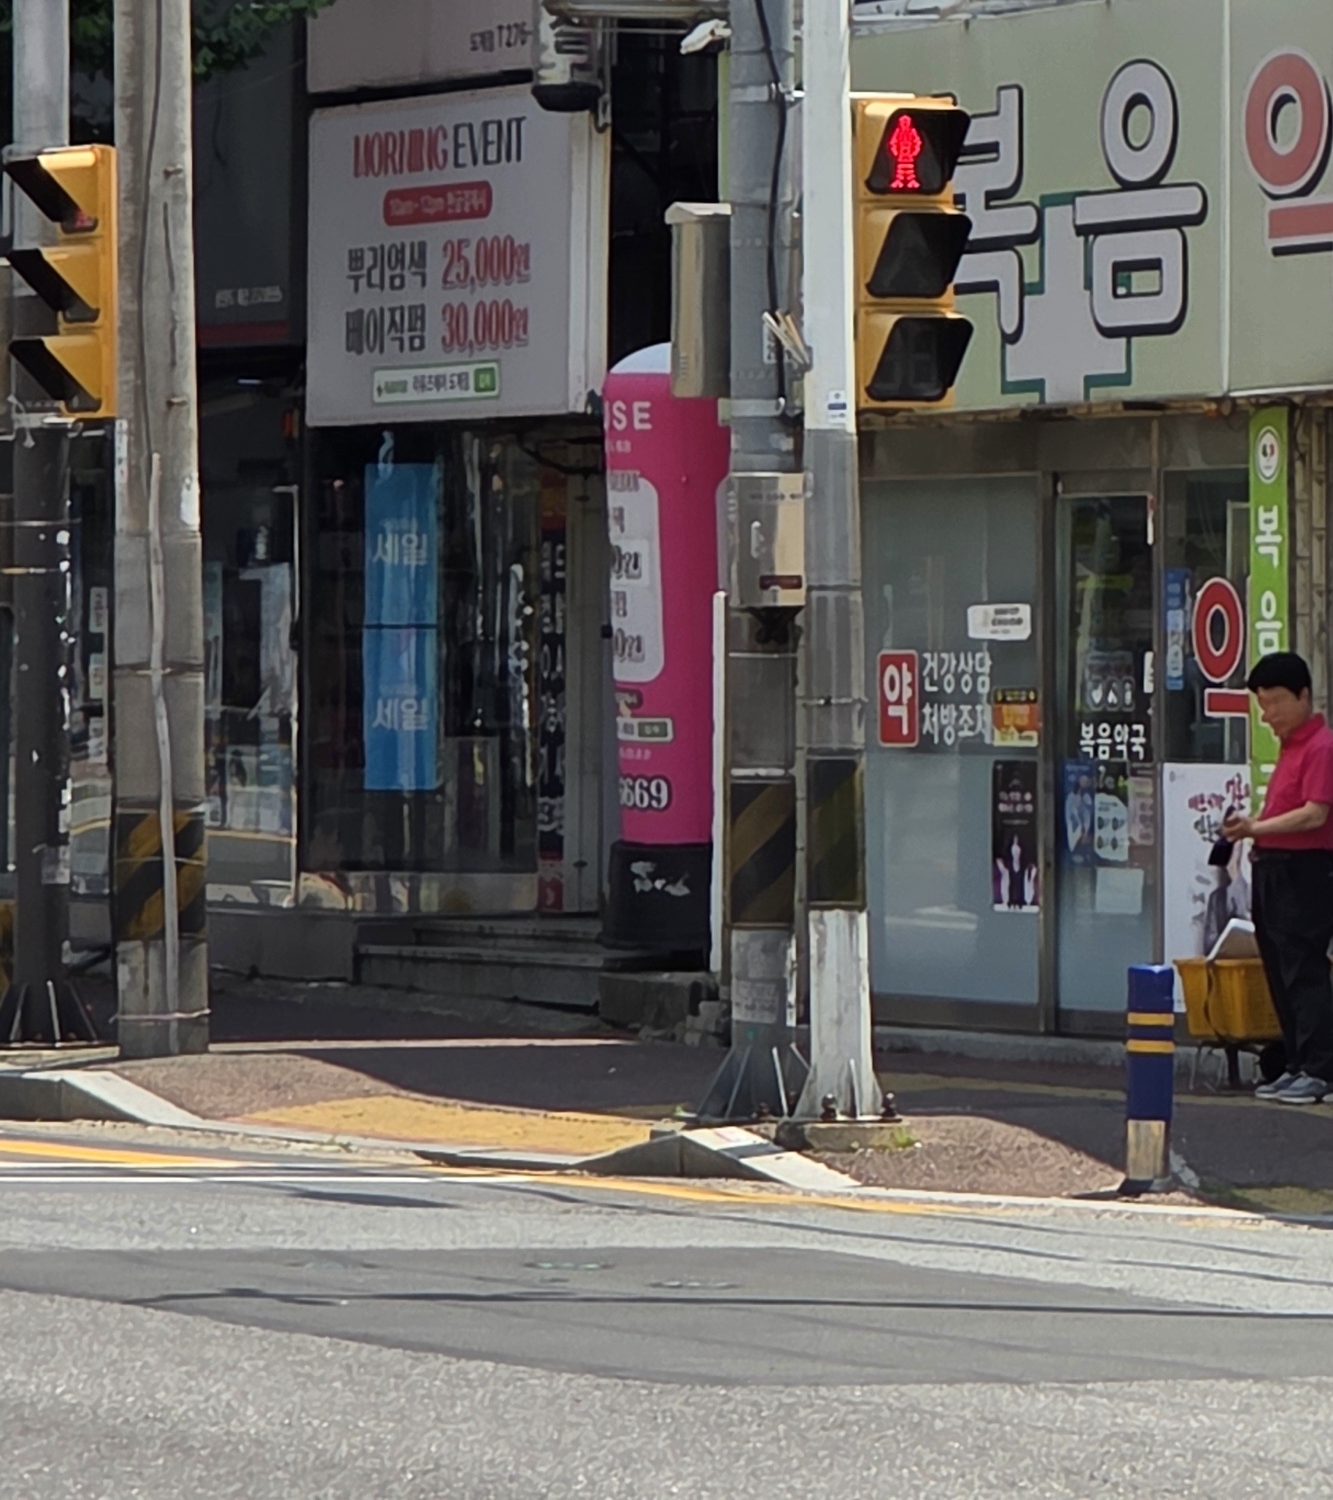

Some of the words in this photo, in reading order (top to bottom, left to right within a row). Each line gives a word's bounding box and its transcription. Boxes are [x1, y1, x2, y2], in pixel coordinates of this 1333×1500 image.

[453, 115, 527, 169] EVENT
[441, 234, 531, 293] 25,000원
[441, 298, 529, 357] 30,000원
[883, 662, 913, 736] 약
[922, 651, 992, 694] 건강상담
[922, 702, 992, 745] 처방조제
[1079, 722, 1146, 761] 복음약국
